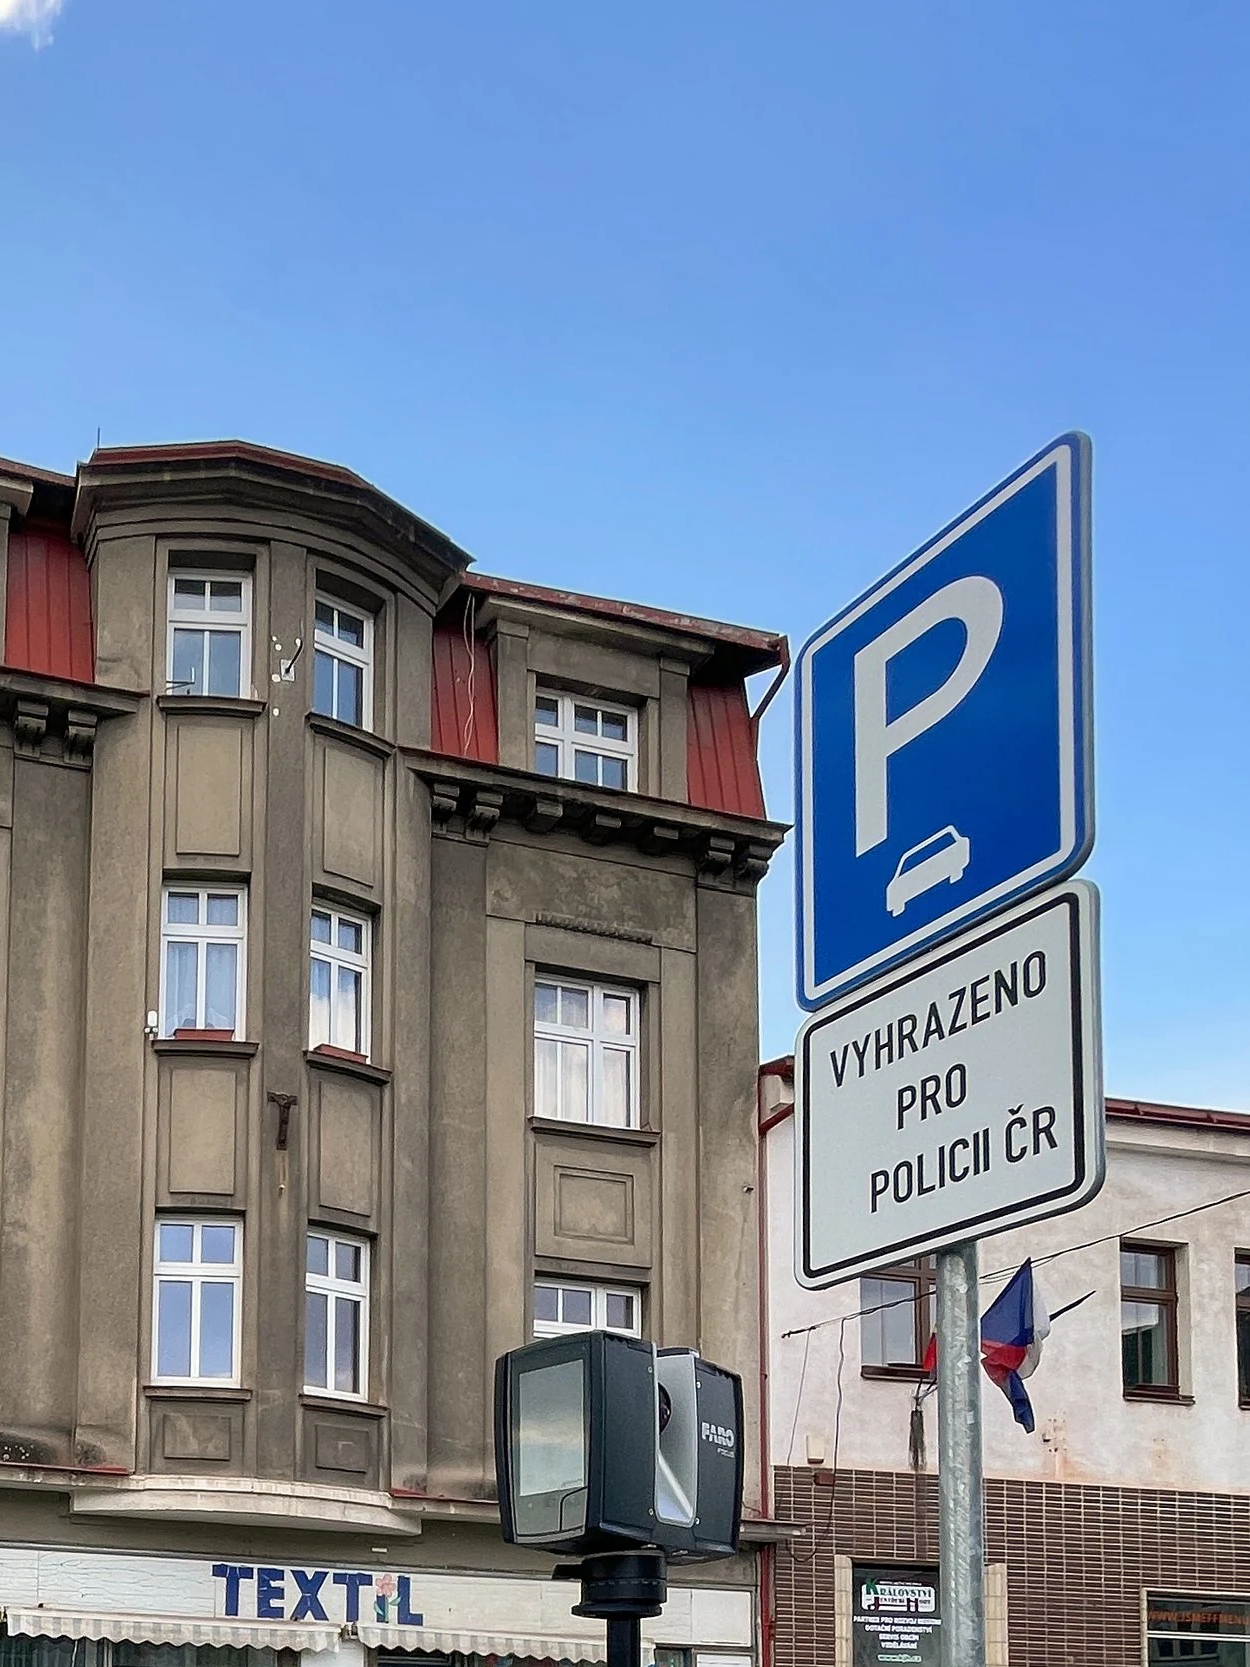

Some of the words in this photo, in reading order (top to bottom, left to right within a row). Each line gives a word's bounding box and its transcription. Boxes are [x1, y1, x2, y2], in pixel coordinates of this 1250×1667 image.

[854, 576, 1004, 857] P
[830, 951, 1046, 1088] VYHRAZENO
[897, 1063, 967, 1131] PRO
[870, 1127, 990, 1214] POLICII
[1004, 1103, 1059, 1163] ČR
[701, 1421, 735, 1447] FARO
